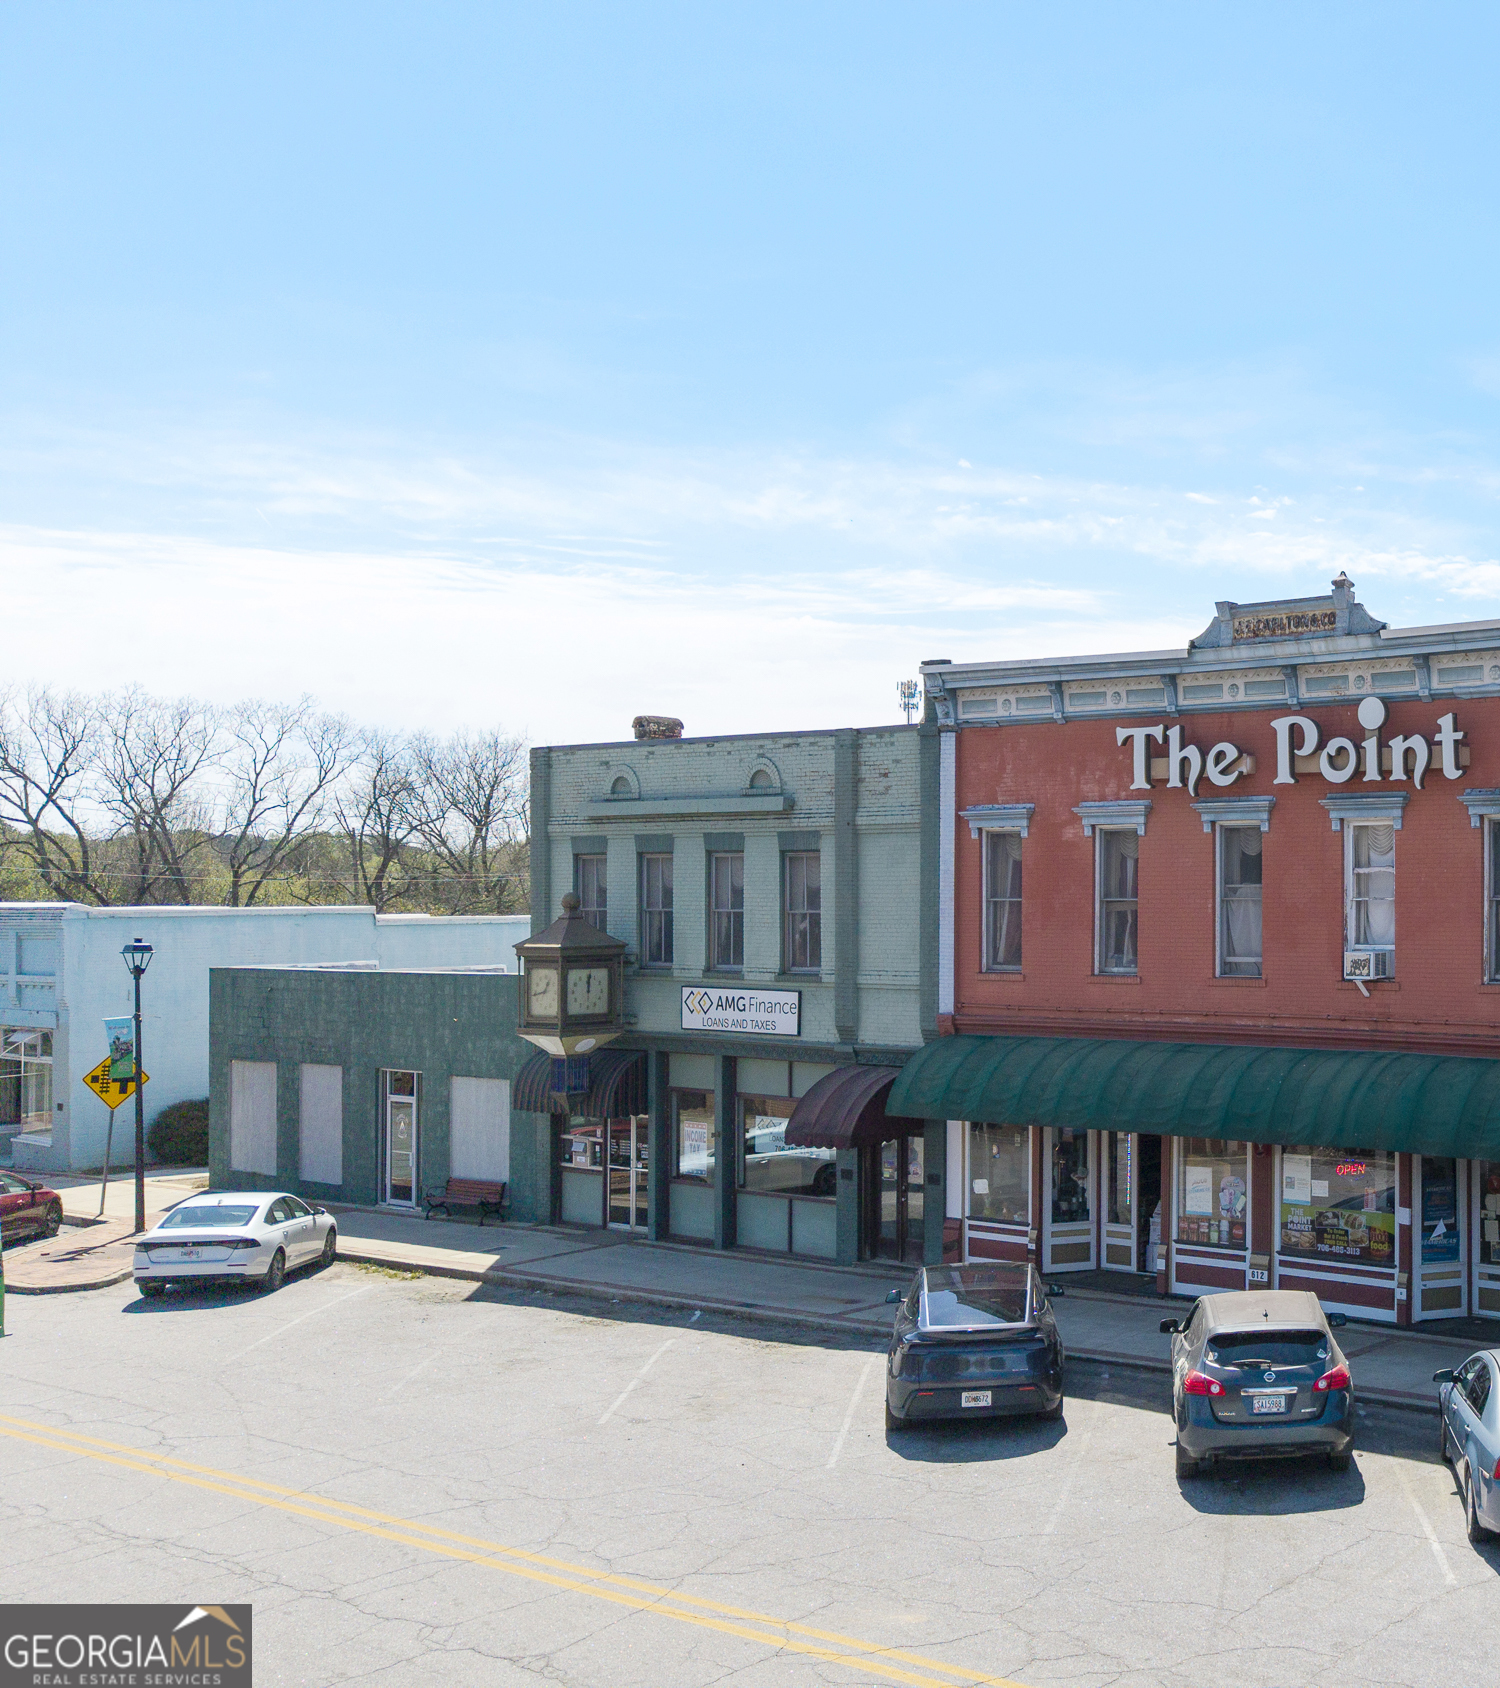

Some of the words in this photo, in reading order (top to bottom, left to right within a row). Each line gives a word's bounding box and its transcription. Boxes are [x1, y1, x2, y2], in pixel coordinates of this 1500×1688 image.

[1115, 723, 1246, 797] The
[1270, 696, 1466, 790] Point
[715, 995, 747, 1013] AMG
[748, 996, 798, 1015] Finance
[702, 1017, 729, 1028] LOANS
[730, 1019, 748, 1029] AND
[750, 1019, 777, 1031] TAXES
[685, 1130, 707, 1143] INCOME
[690, 1143, 701, 1152] TAX
[1335, 1163, 1366, 1176] OPEN
[1290, 1208, 1304, 1216] THE
[1287, 1215, 1312, 1225] POINT
[1287, 1223, 1313, 1231] MARKET
[1251, 1270, 1265, 1280] 612
